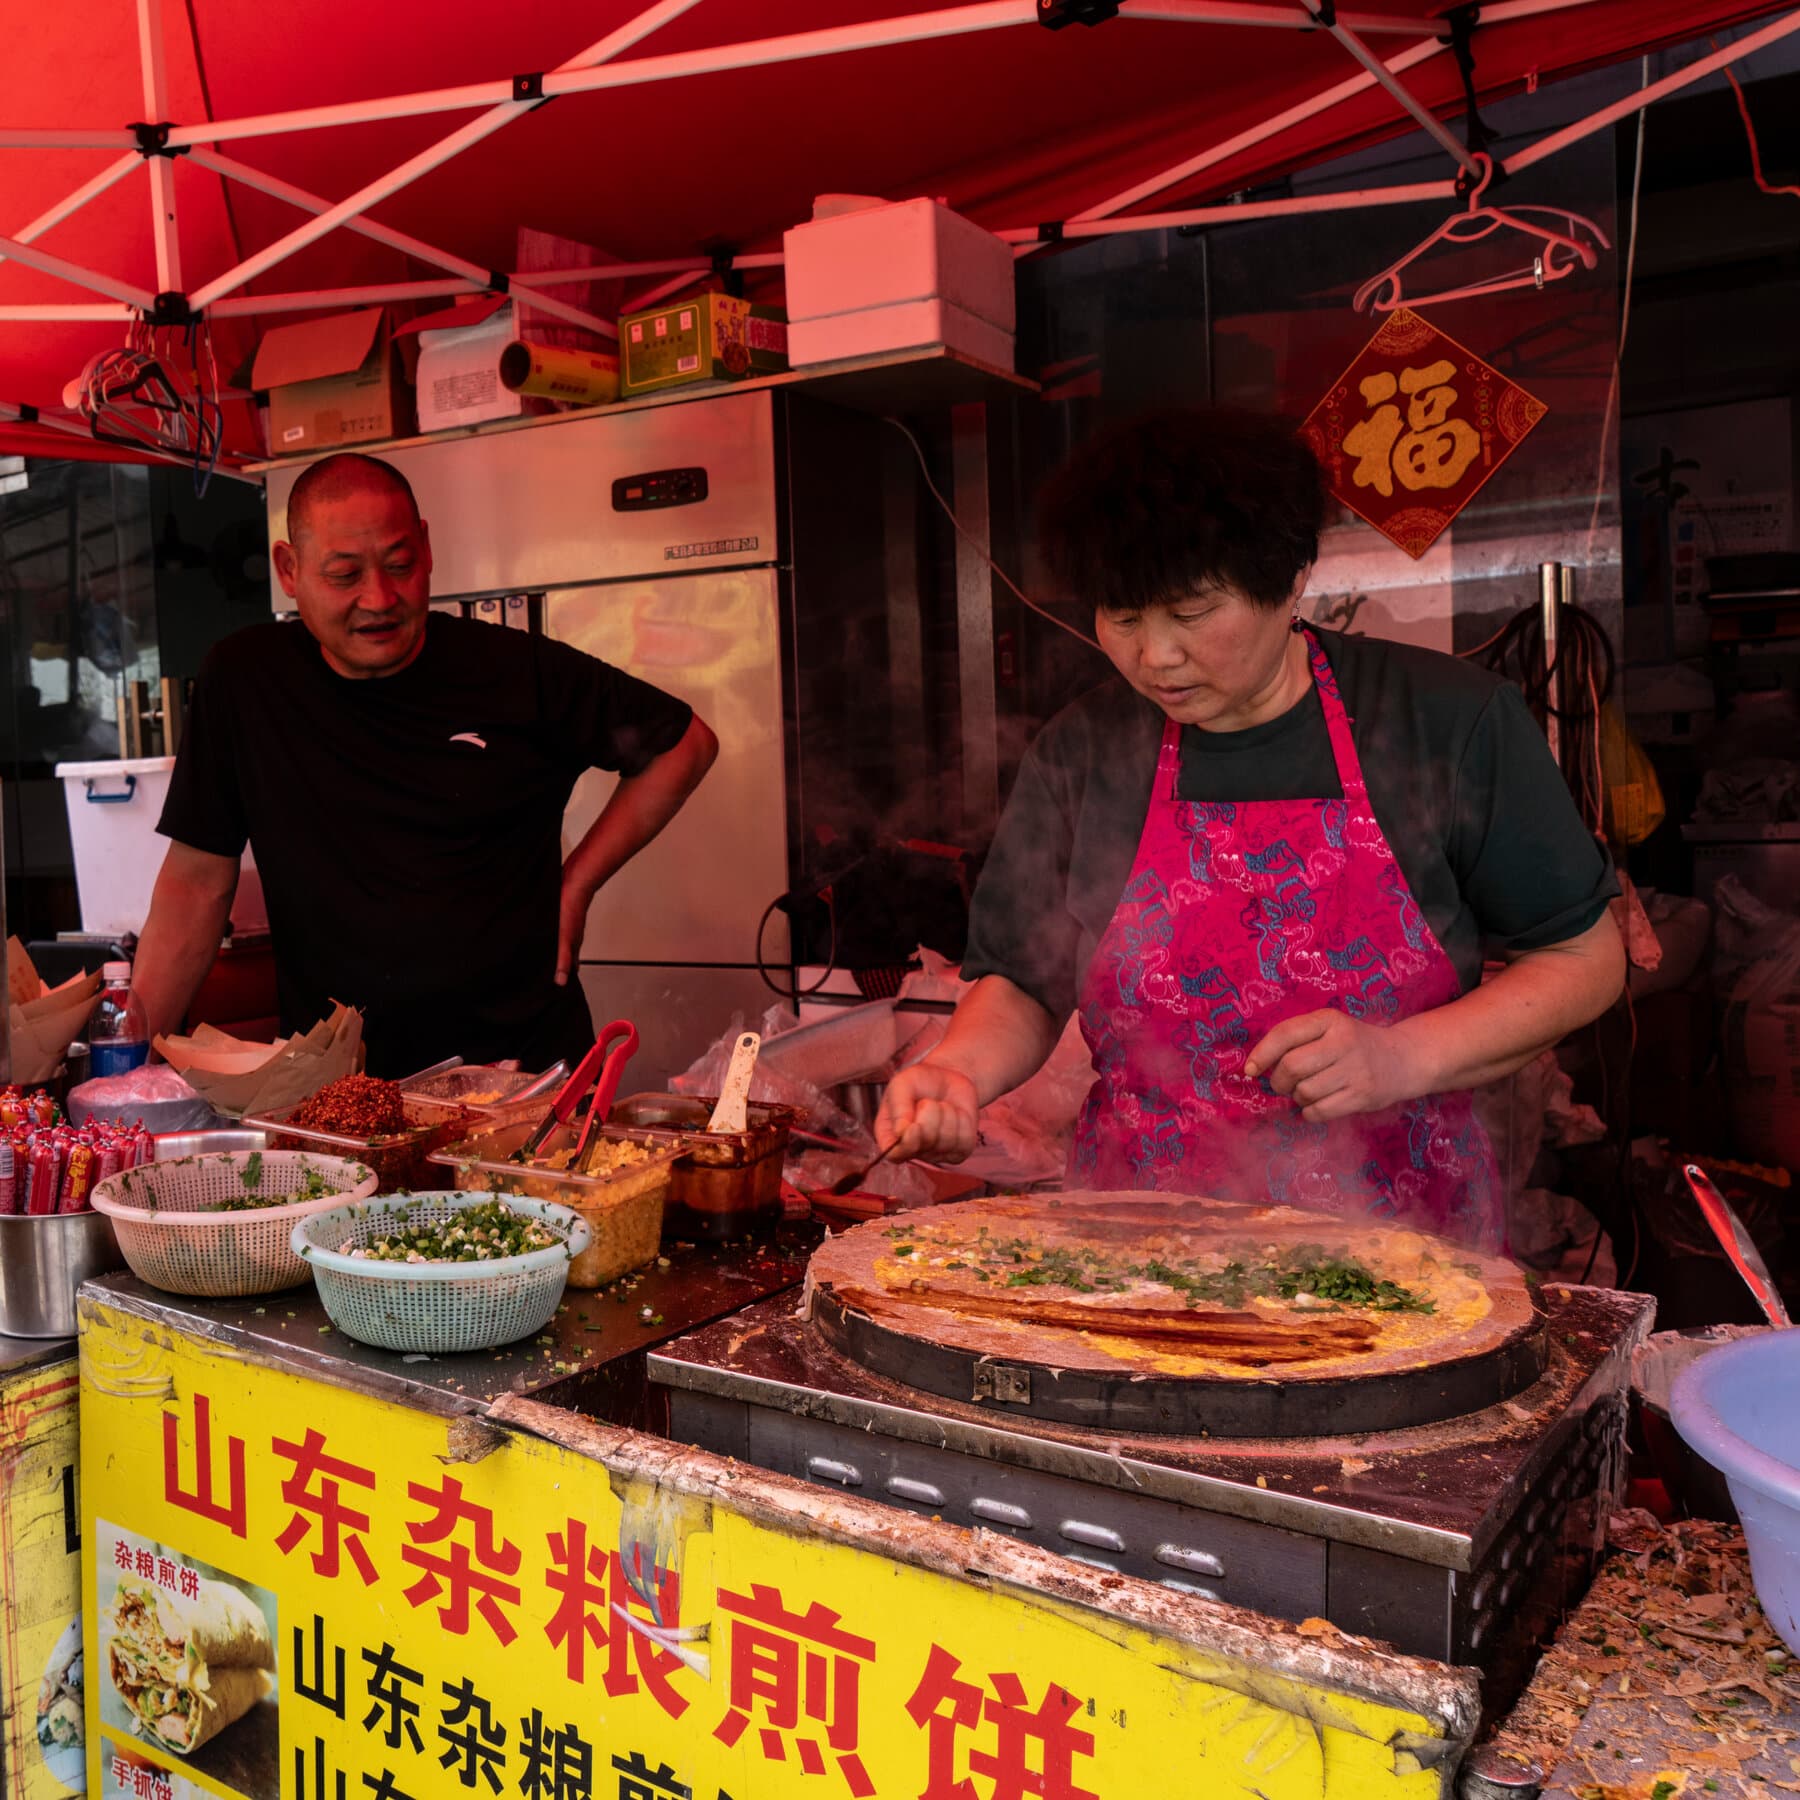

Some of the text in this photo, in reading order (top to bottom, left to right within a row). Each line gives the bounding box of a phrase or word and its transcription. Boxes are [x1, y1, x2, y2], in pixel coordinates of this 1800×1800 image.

[1342, 359, 1481, 498] 福
[115, 1540, 200, 1600] 杂粮煎饼
[163, 1392, 1100, 1800] 山东杂粮煎饼
